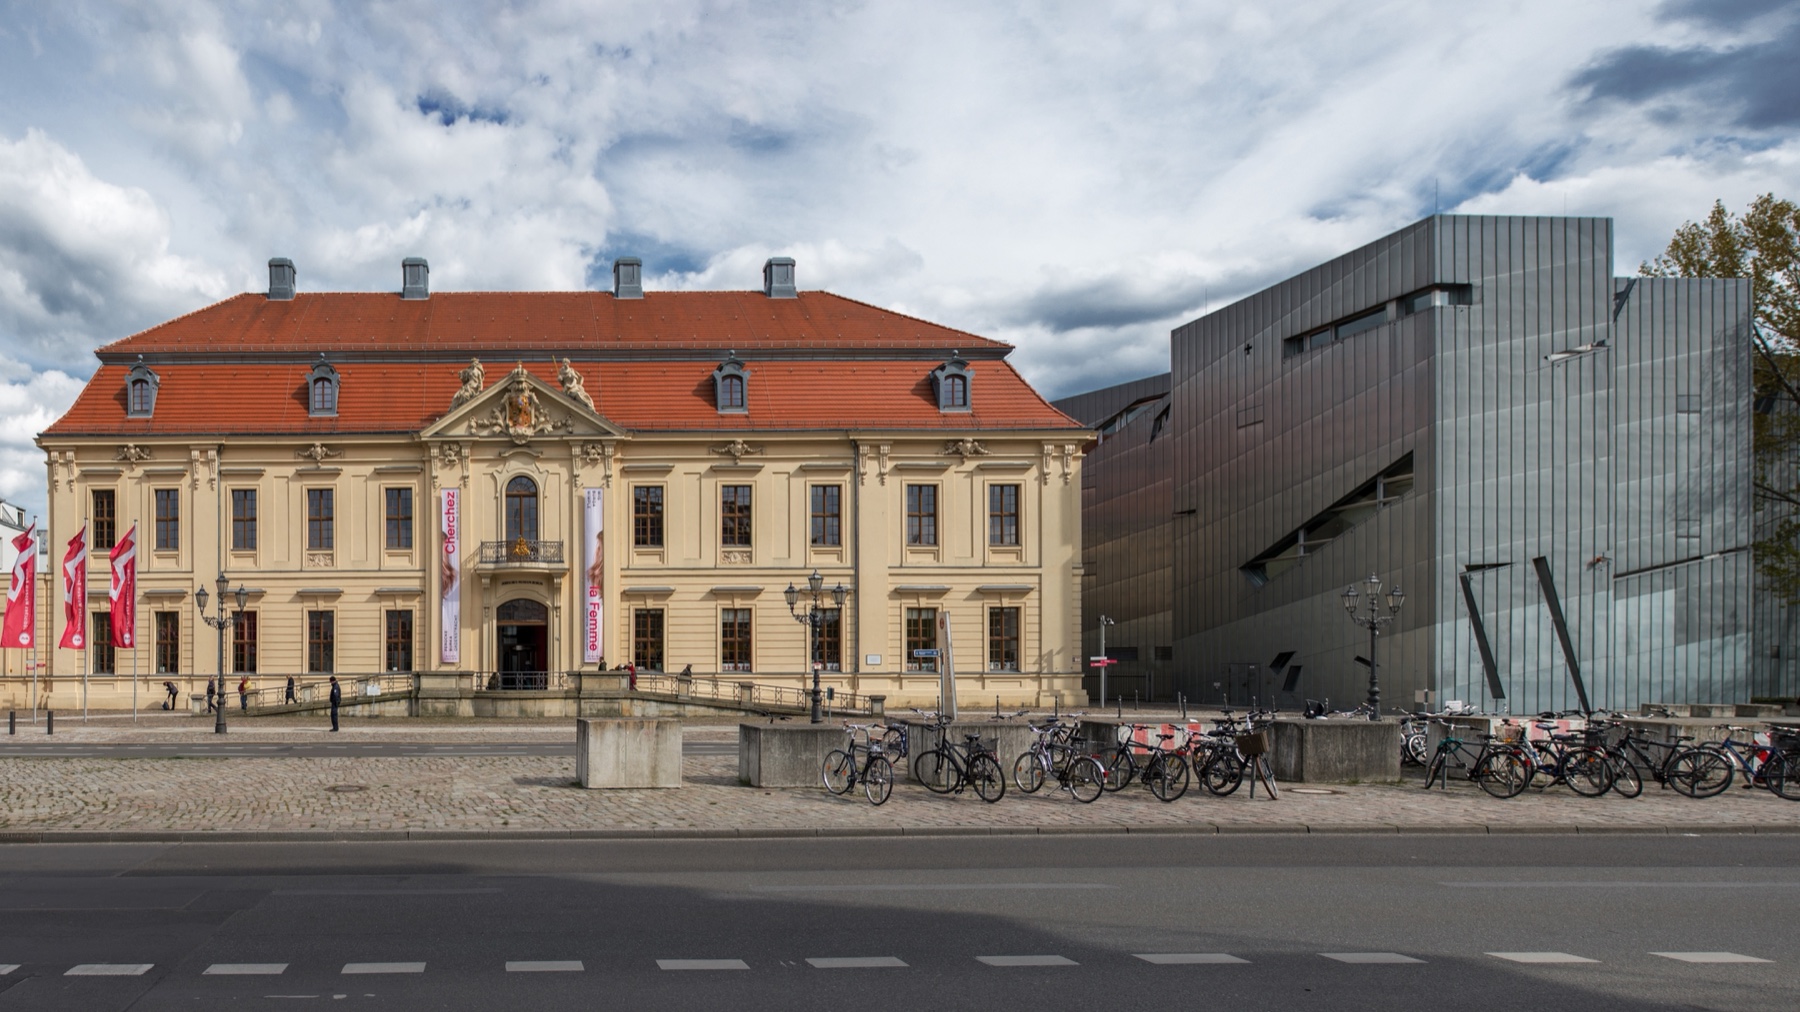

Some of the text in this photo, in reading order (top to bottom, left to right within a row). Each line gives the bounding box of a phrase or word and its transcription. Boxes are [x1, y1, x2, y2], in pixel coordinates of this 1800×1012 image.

[444, 491, 455, 554] Cherchez
[589, 585, 602, 597] la
[589, 602, 600, 651] Femme
